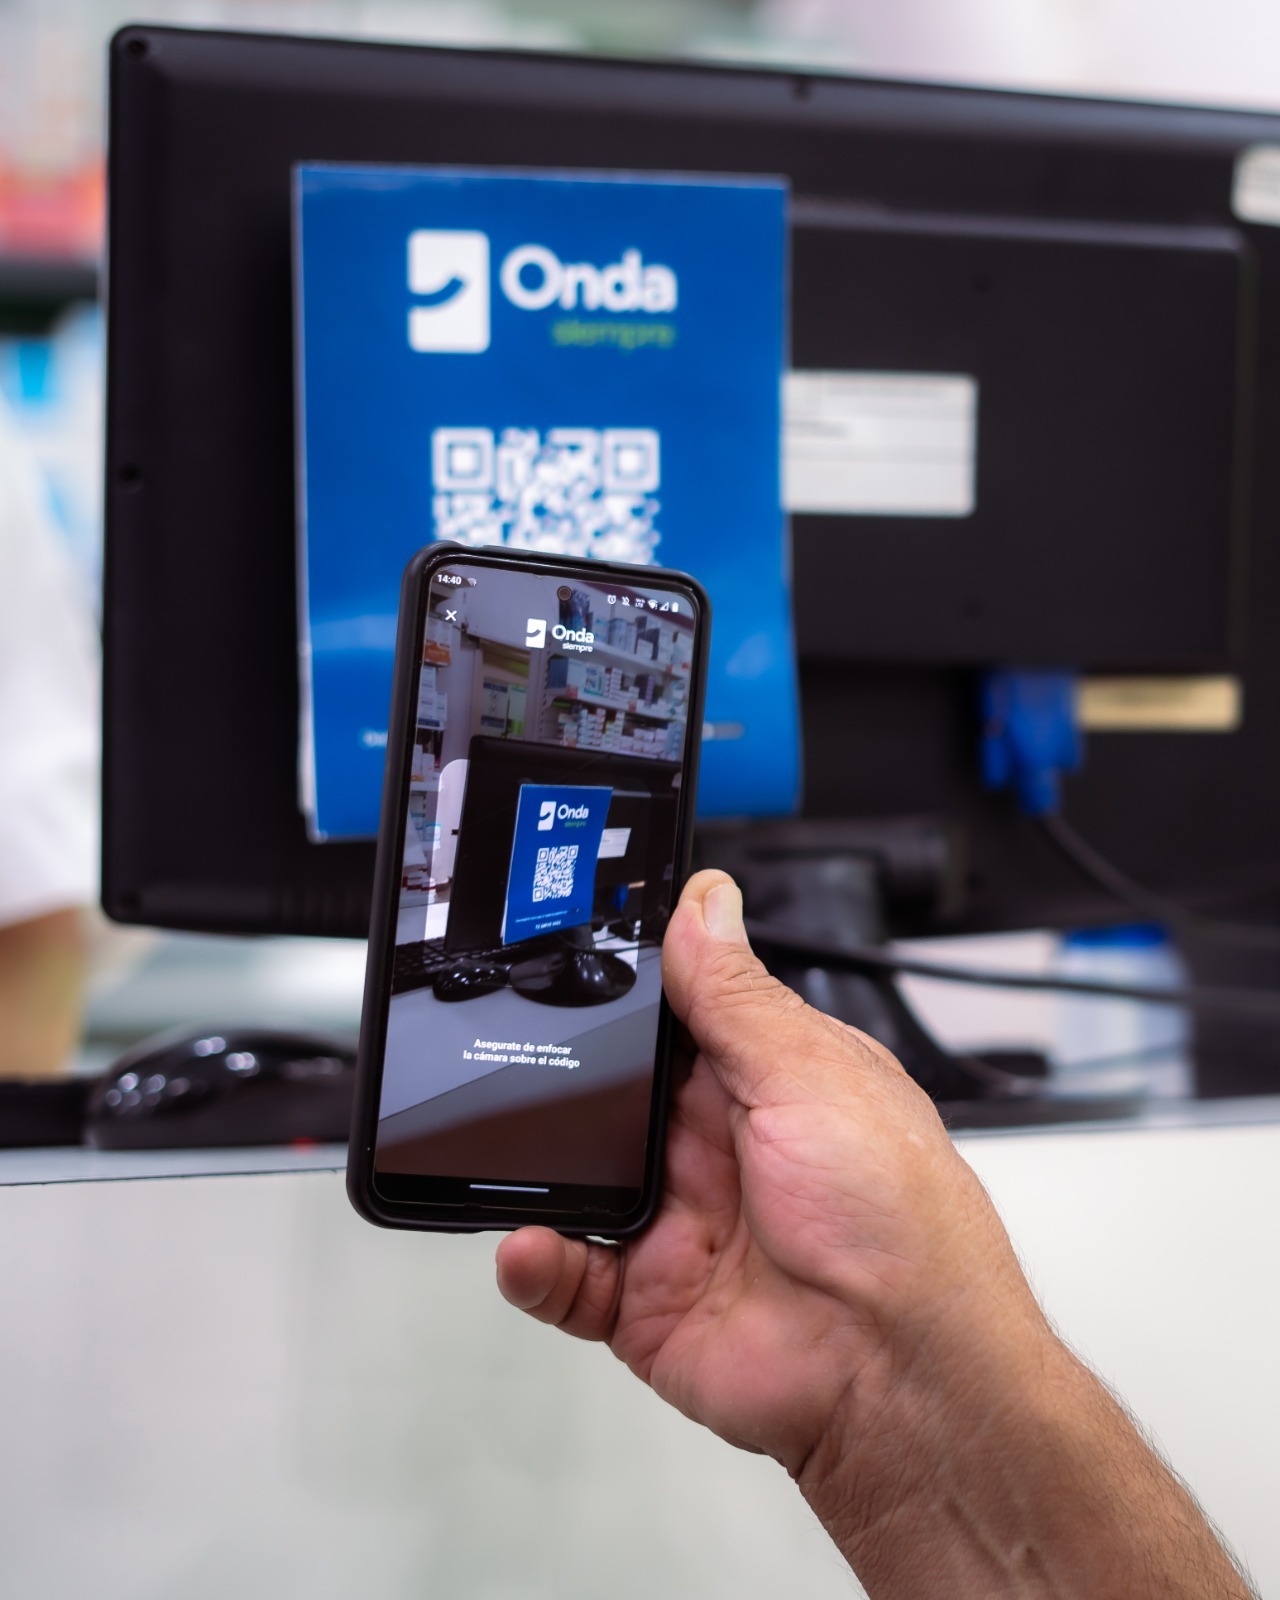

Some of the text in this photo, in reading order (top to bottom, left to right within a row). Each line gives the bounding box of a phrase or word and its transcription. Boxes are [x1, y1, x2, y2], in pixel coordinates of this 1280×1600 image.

[501, 244, 677, 312] Onda
[437, 574, 462, 585] 14:40
[551, 624, 594, 643] Onda
[562, 642, 593, 653] siempre
[557, 804, 589, 819] Onda
[474, 1039, 572, 1055] Asegurate de enfocar
[463, 1050, 580, 1069] la cámara sobre el código
